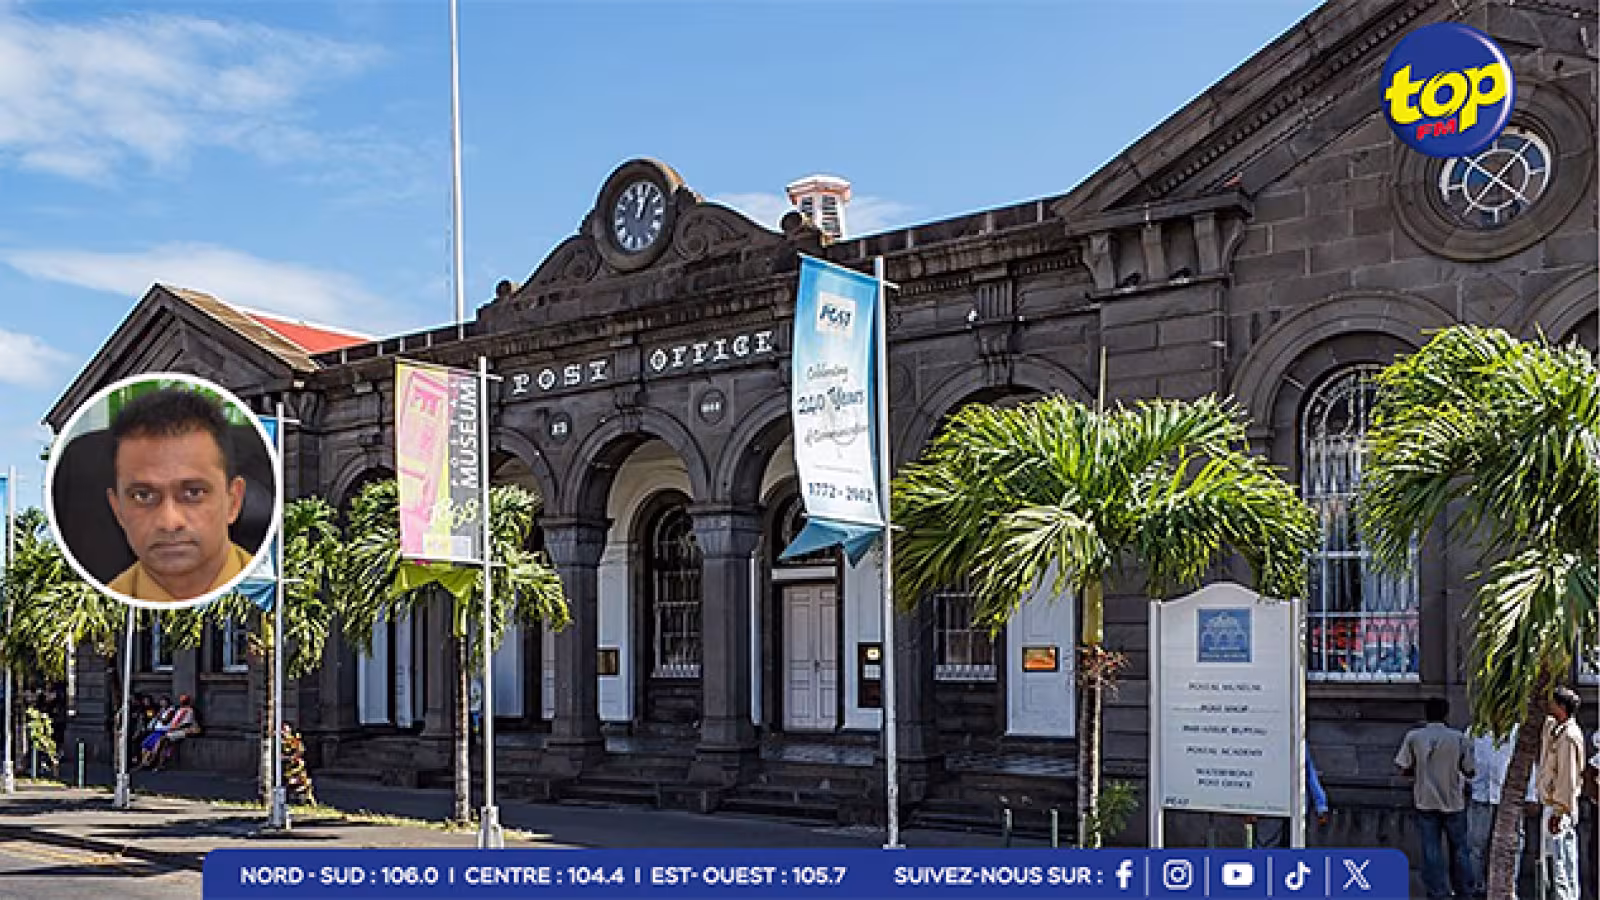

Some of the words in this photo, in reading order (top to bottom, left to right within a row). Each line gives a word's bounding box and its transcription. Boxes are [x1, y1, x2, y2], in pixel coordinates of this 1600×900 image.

[511, 359, 608, 395] POST
[650, 330, 773, 372] OFFICE
[460, 377, 477, 489] MUSEUM
